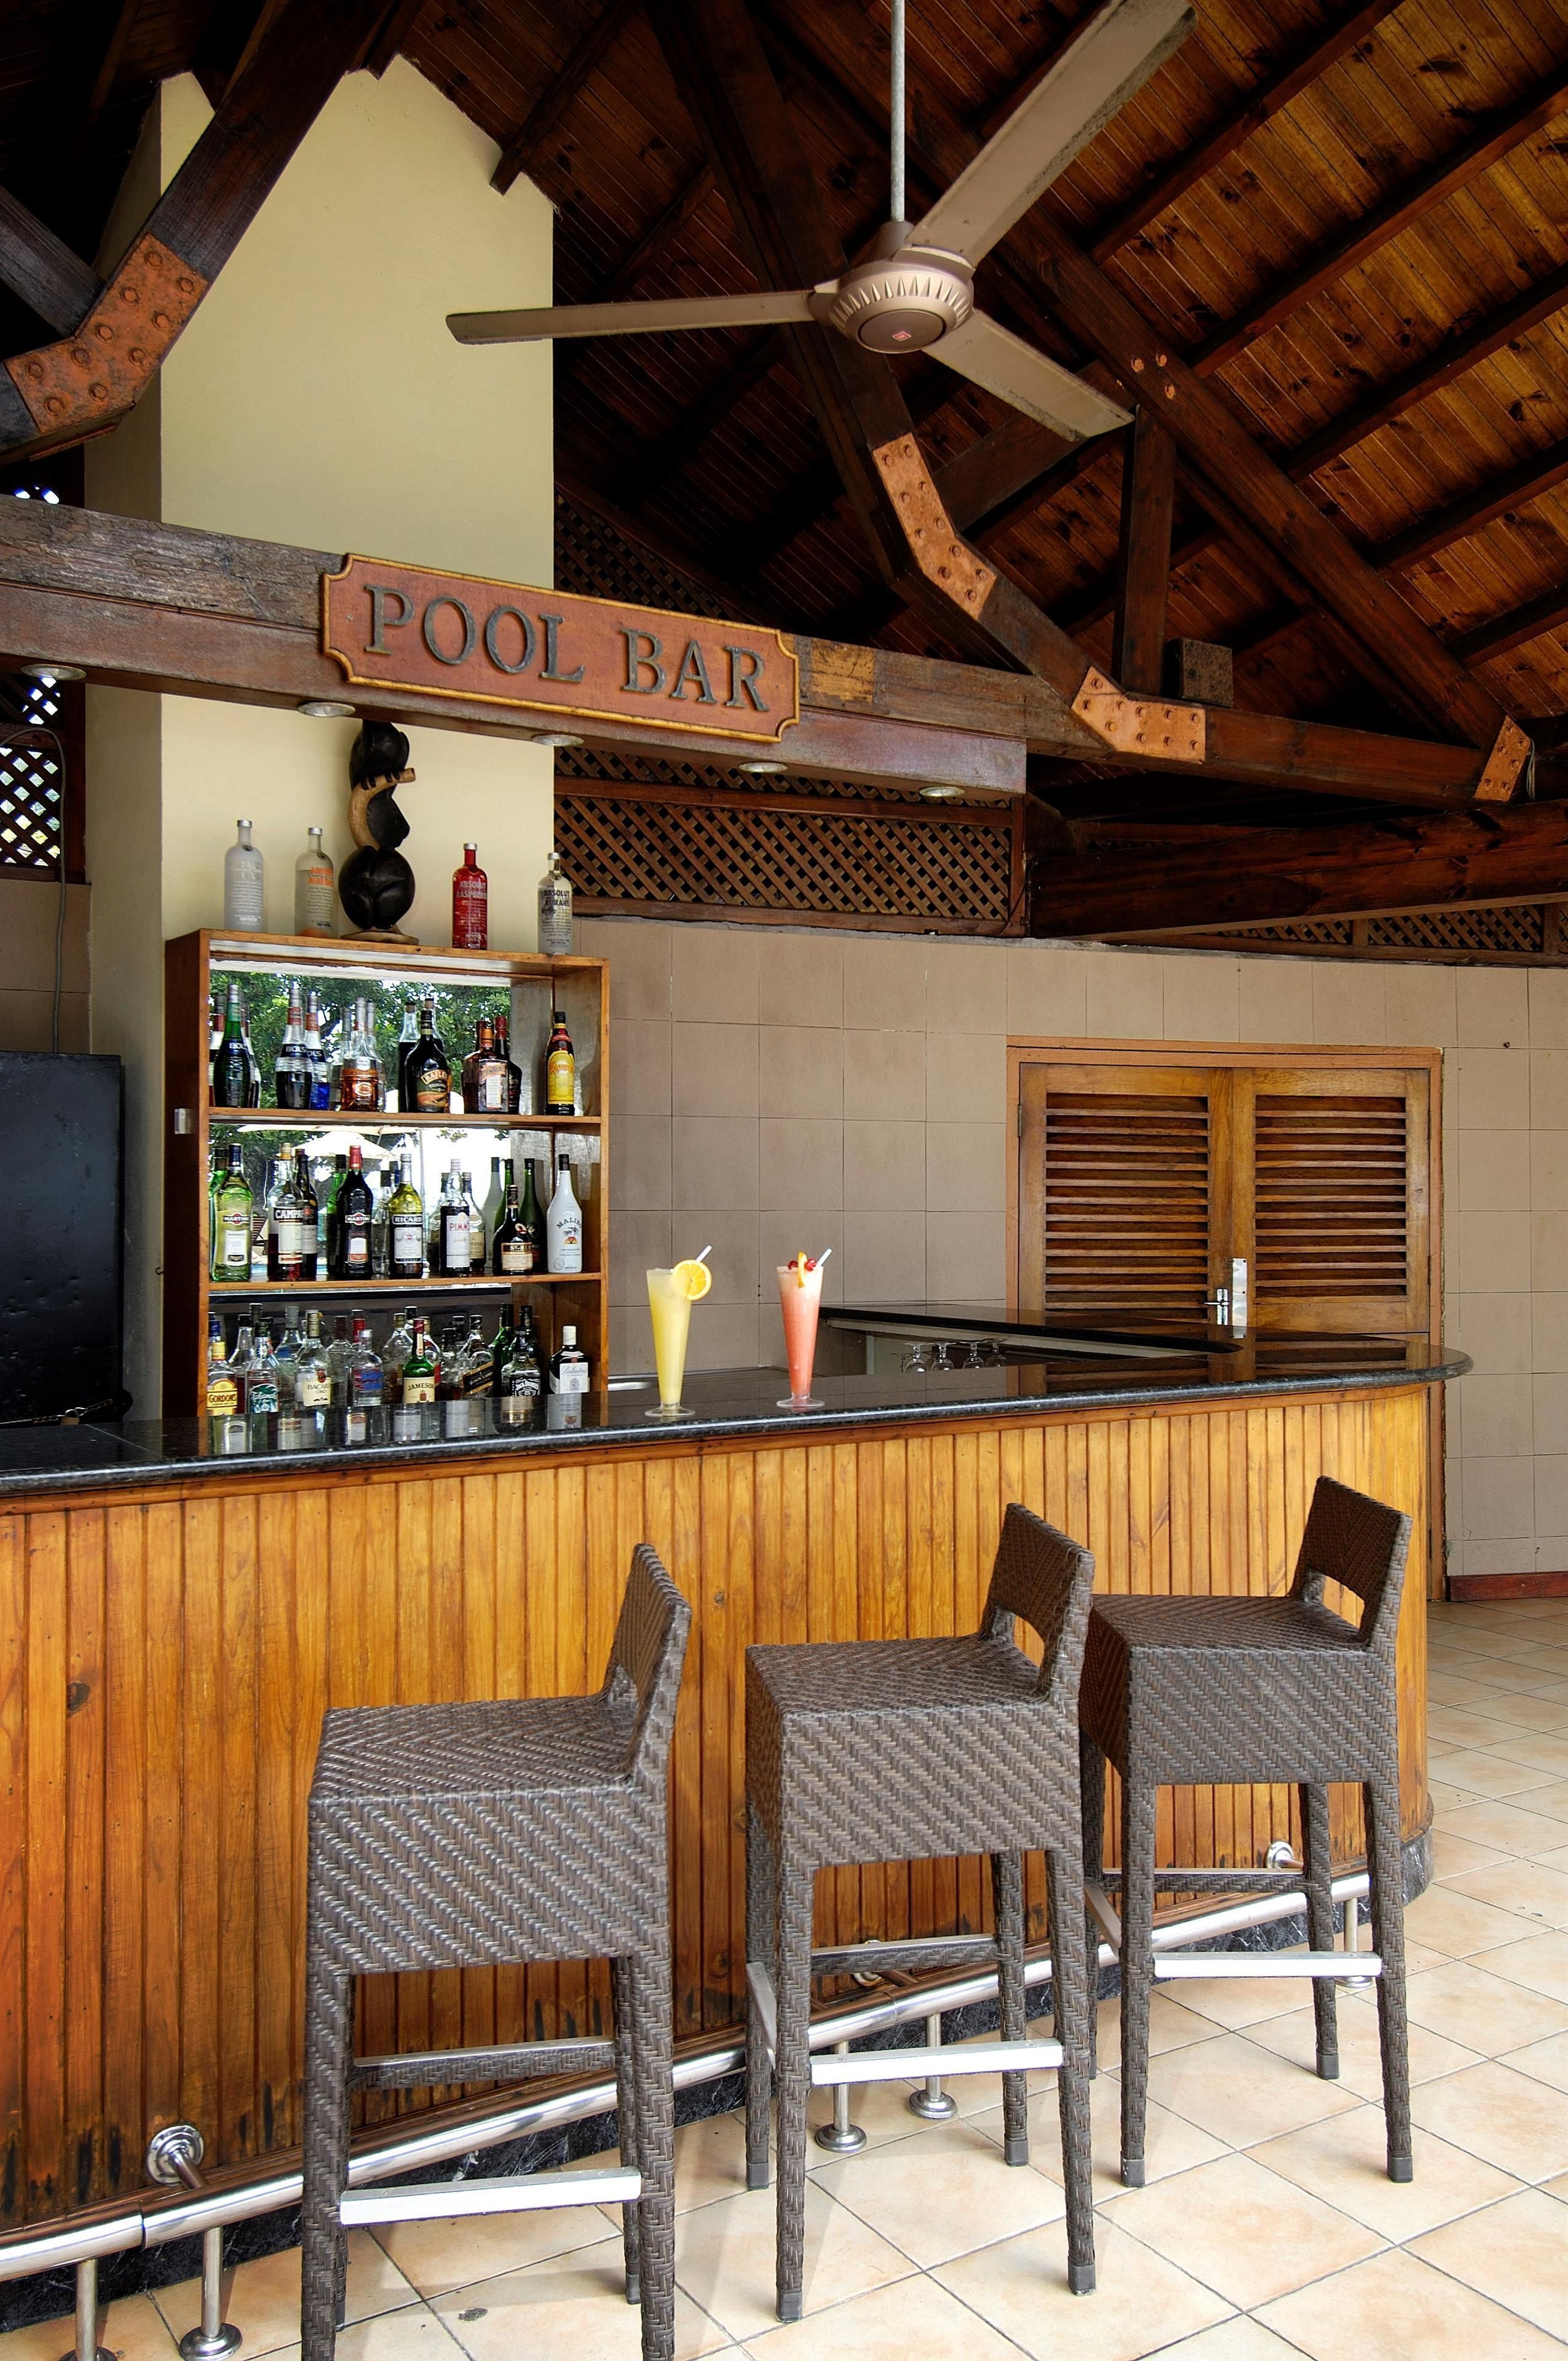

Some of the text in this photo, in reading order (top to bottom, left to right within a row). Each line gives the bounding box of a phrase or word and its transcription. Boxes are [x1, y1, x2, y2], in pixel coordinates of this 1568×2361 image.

[364, 583, 770, 713] POOL BAR
[275, 1209, 303, 1219] CAMPA
[408, 1382, 434, 1391] JAMESON
